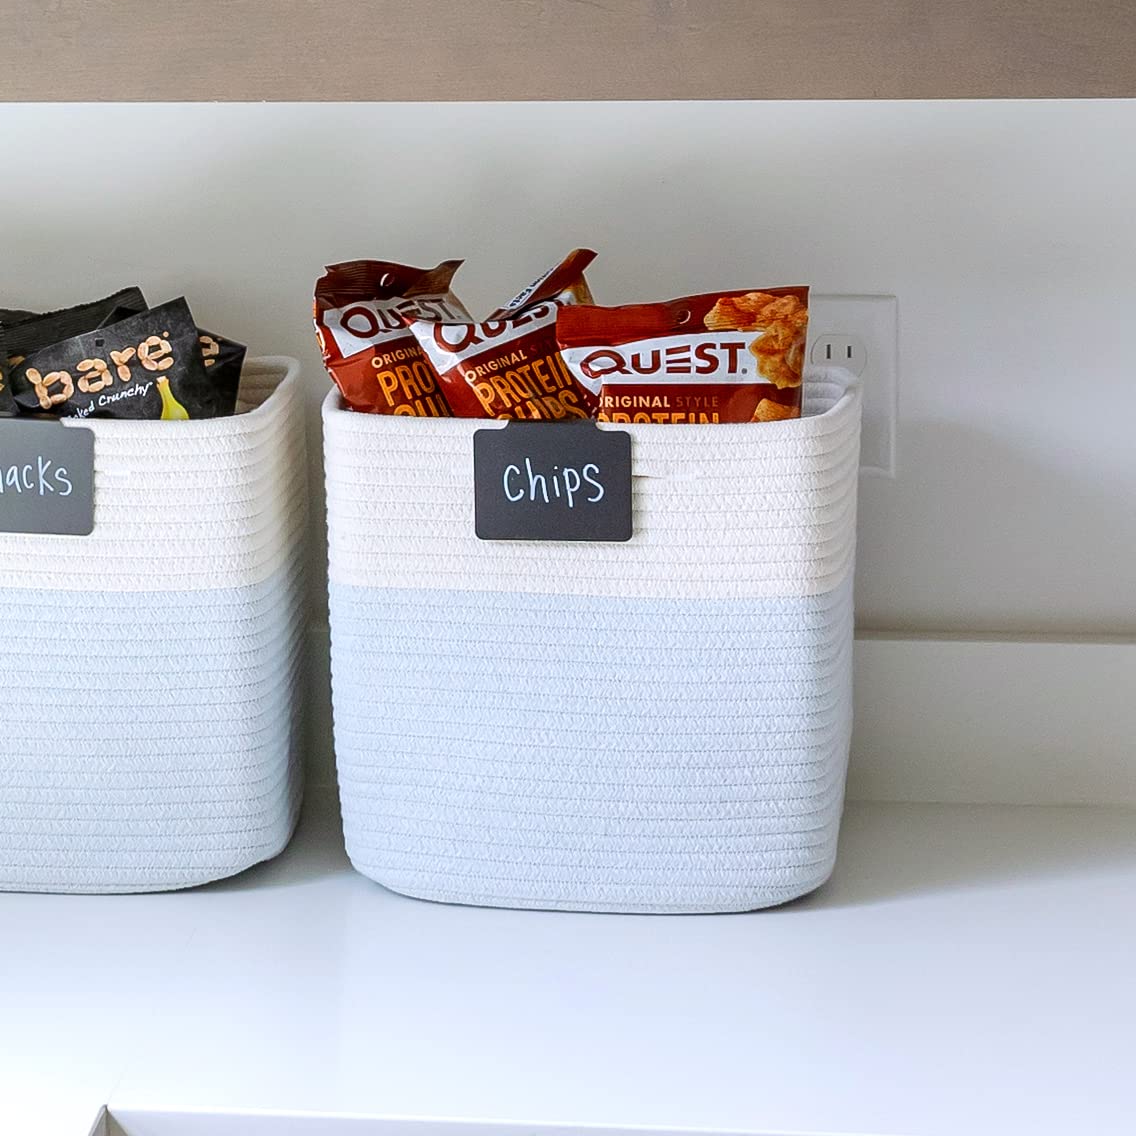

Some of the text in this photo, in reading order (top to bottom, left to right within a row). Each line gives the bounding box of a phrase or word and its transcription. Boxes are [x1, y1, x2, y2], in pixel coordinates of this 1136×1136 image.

[339, 298, 457, 339] QUEST
[25, 335, 175, 410] bare
[371, 345, 424, 369] ORIGINA
[464, 349, 528, 383] ORIGINAL
[579, 341, 746, 379] QUEST
[98, 382, 153, 407] Crunchy
[675, 396, 719, 408] STYLE
